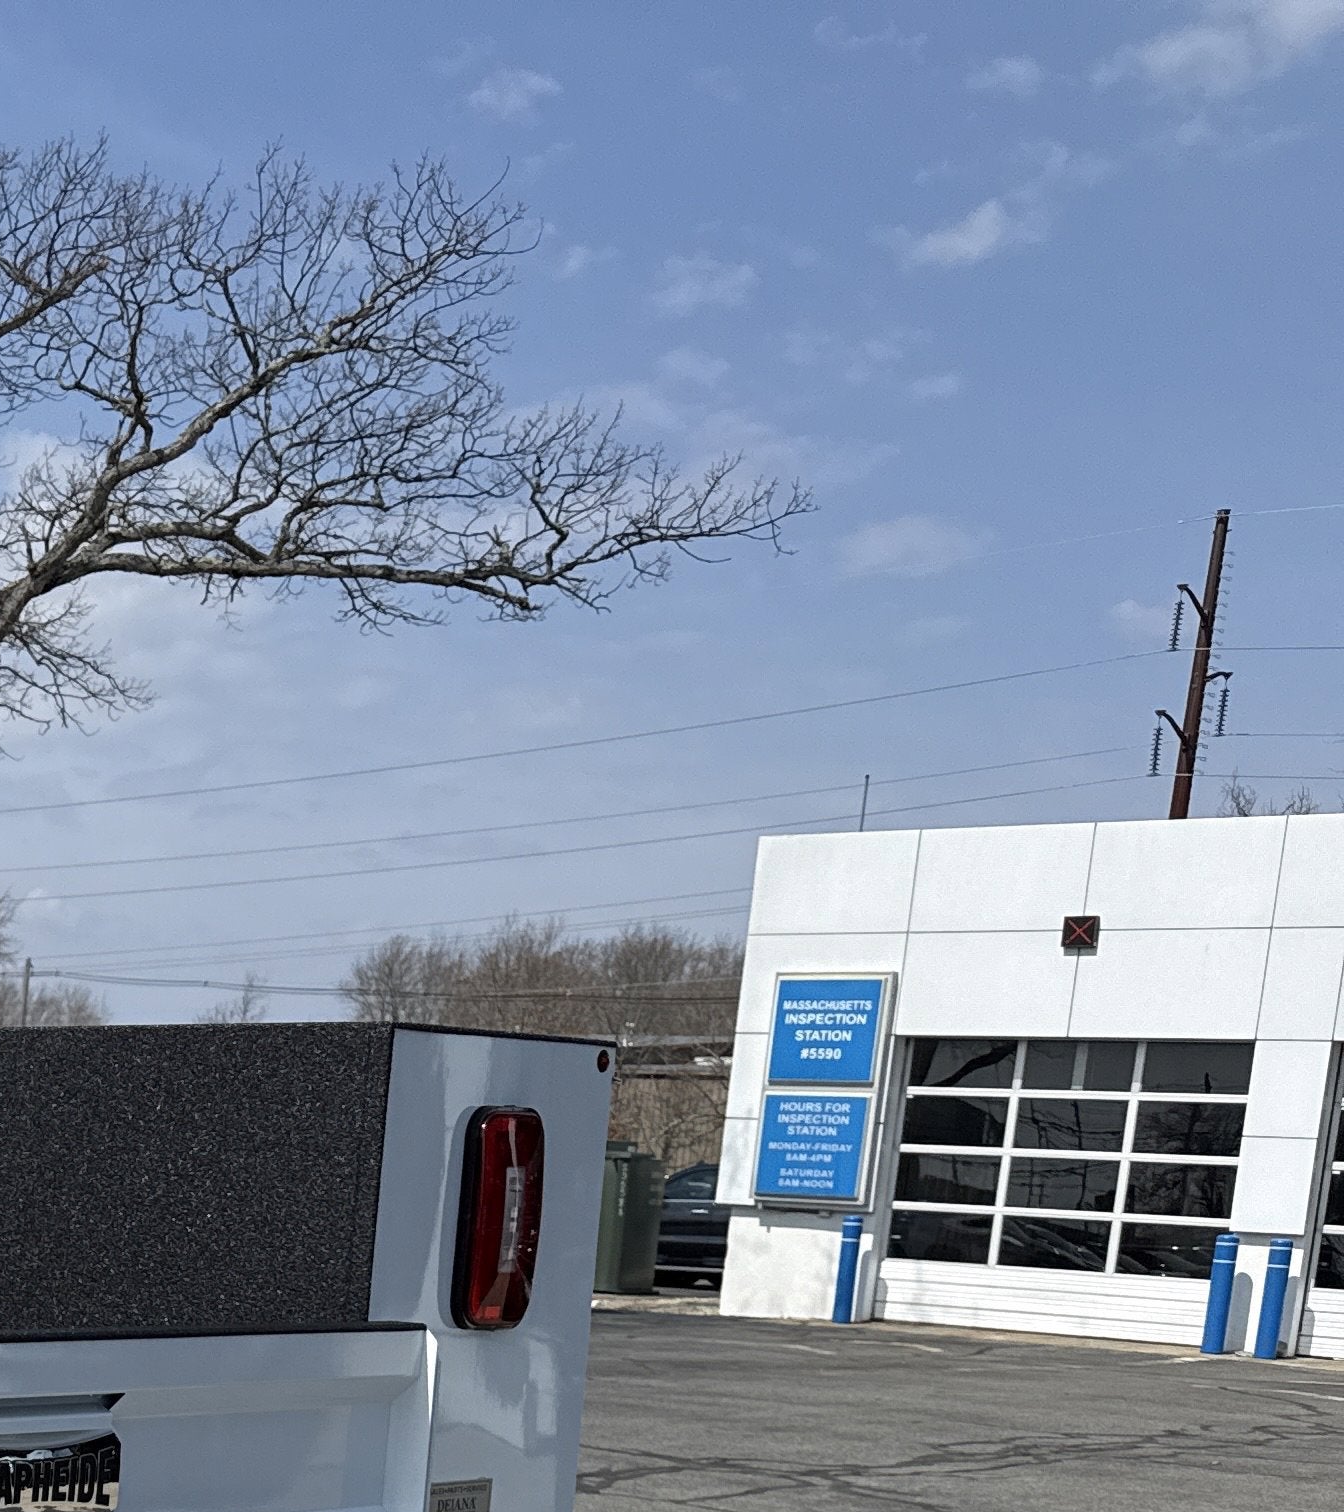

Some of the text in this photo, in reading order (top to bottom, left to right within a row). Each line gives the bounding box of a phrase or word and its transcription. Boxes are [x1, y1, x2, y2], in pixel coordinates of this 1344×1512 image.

[782, 1000, 872, 1011] MASSACHUSETTS
[784, 1013, 867, 1025] INSPECTION
[794, 1029, 852, 1042] STATION
[800, 1047, 842, 1060] #5590
[779, 1102, 851, 1113] HOURS FOR
[777, 1114, 850, 1125] INSPECTION
[787, 1126, 837, 1136] STATION
[779, 1168, 835, 1178] SATURDAY
